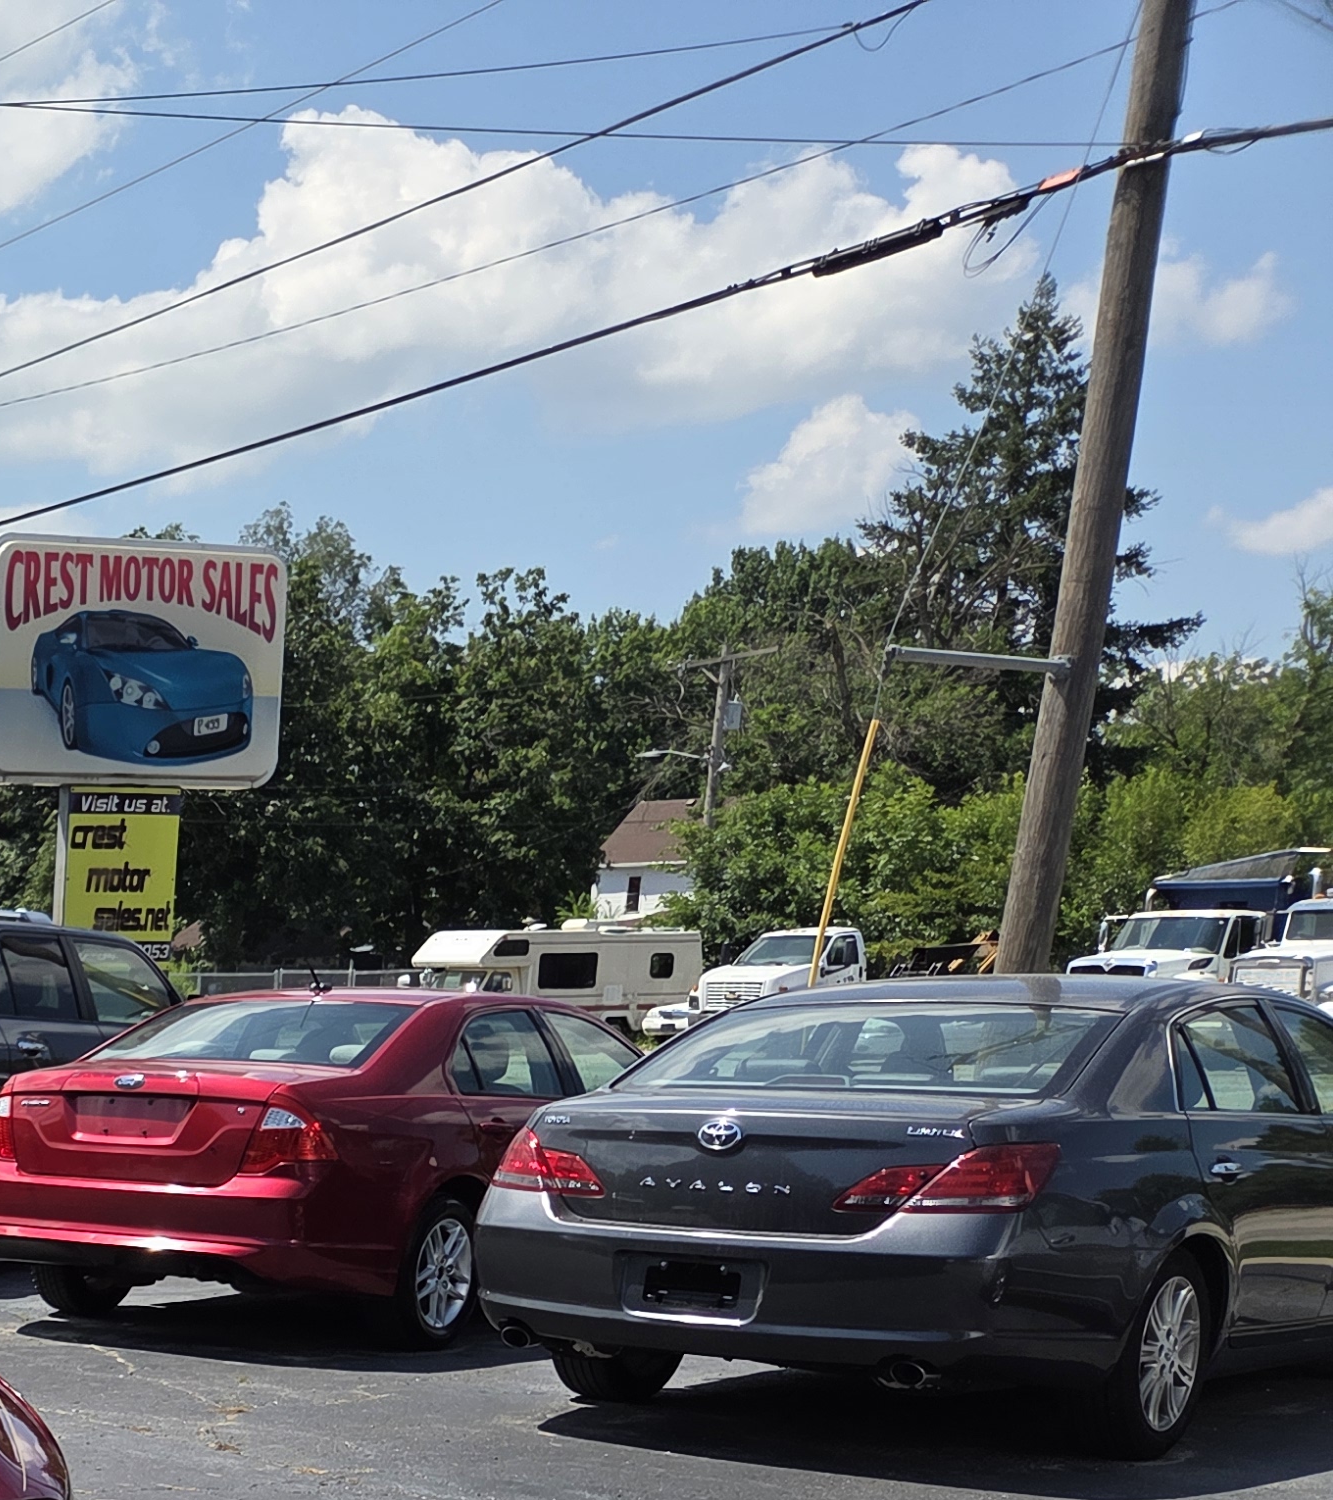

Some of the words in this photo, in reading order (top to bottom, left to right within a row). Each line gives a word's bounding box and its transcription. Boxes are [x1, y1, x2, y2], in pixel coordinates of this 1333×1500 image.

[4, 549, 94, 631] CREST
[99, 553, 195, 608] MOTOR
[202, 558, 280, 644] SALES
[81, 794, 120, 812] Visit
[123, 798, 148, 813] us
[70, 817, 127, 850] crest
[85, 861, 151, 893] motor
[92, 900, 171, 932] sales.net
[639, 1176, 791, 1195] AVALON
